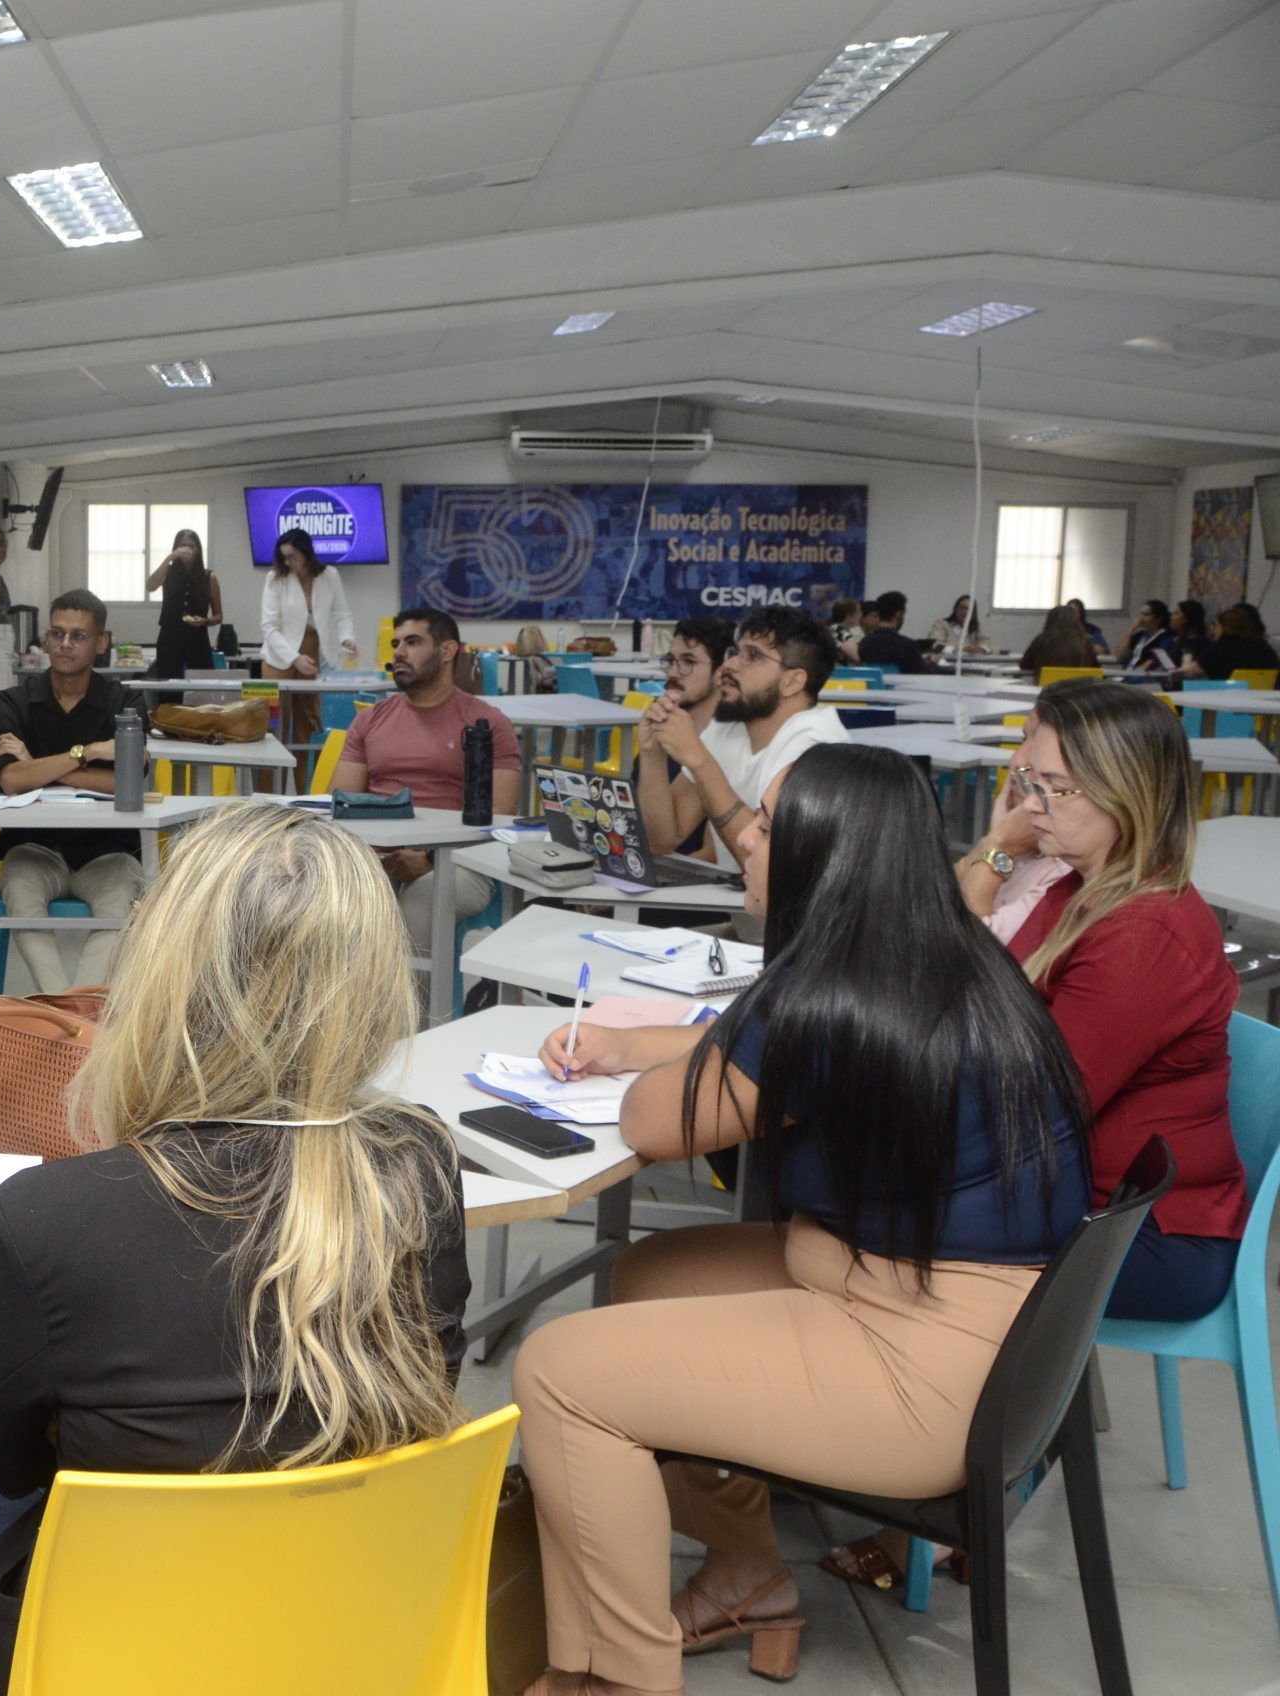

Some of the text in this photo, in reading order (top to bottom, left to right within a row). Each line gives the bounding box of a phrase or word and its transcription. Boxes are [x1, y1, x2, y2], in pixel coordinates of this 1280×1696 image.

[296, 501, 333, 514] OFICINA
[650, 506, 847, 536] Inovação Tecnológica
[667, 537, 846, 564] Social e Acadêmica
[700, 584, 803, 608] CESMAC
